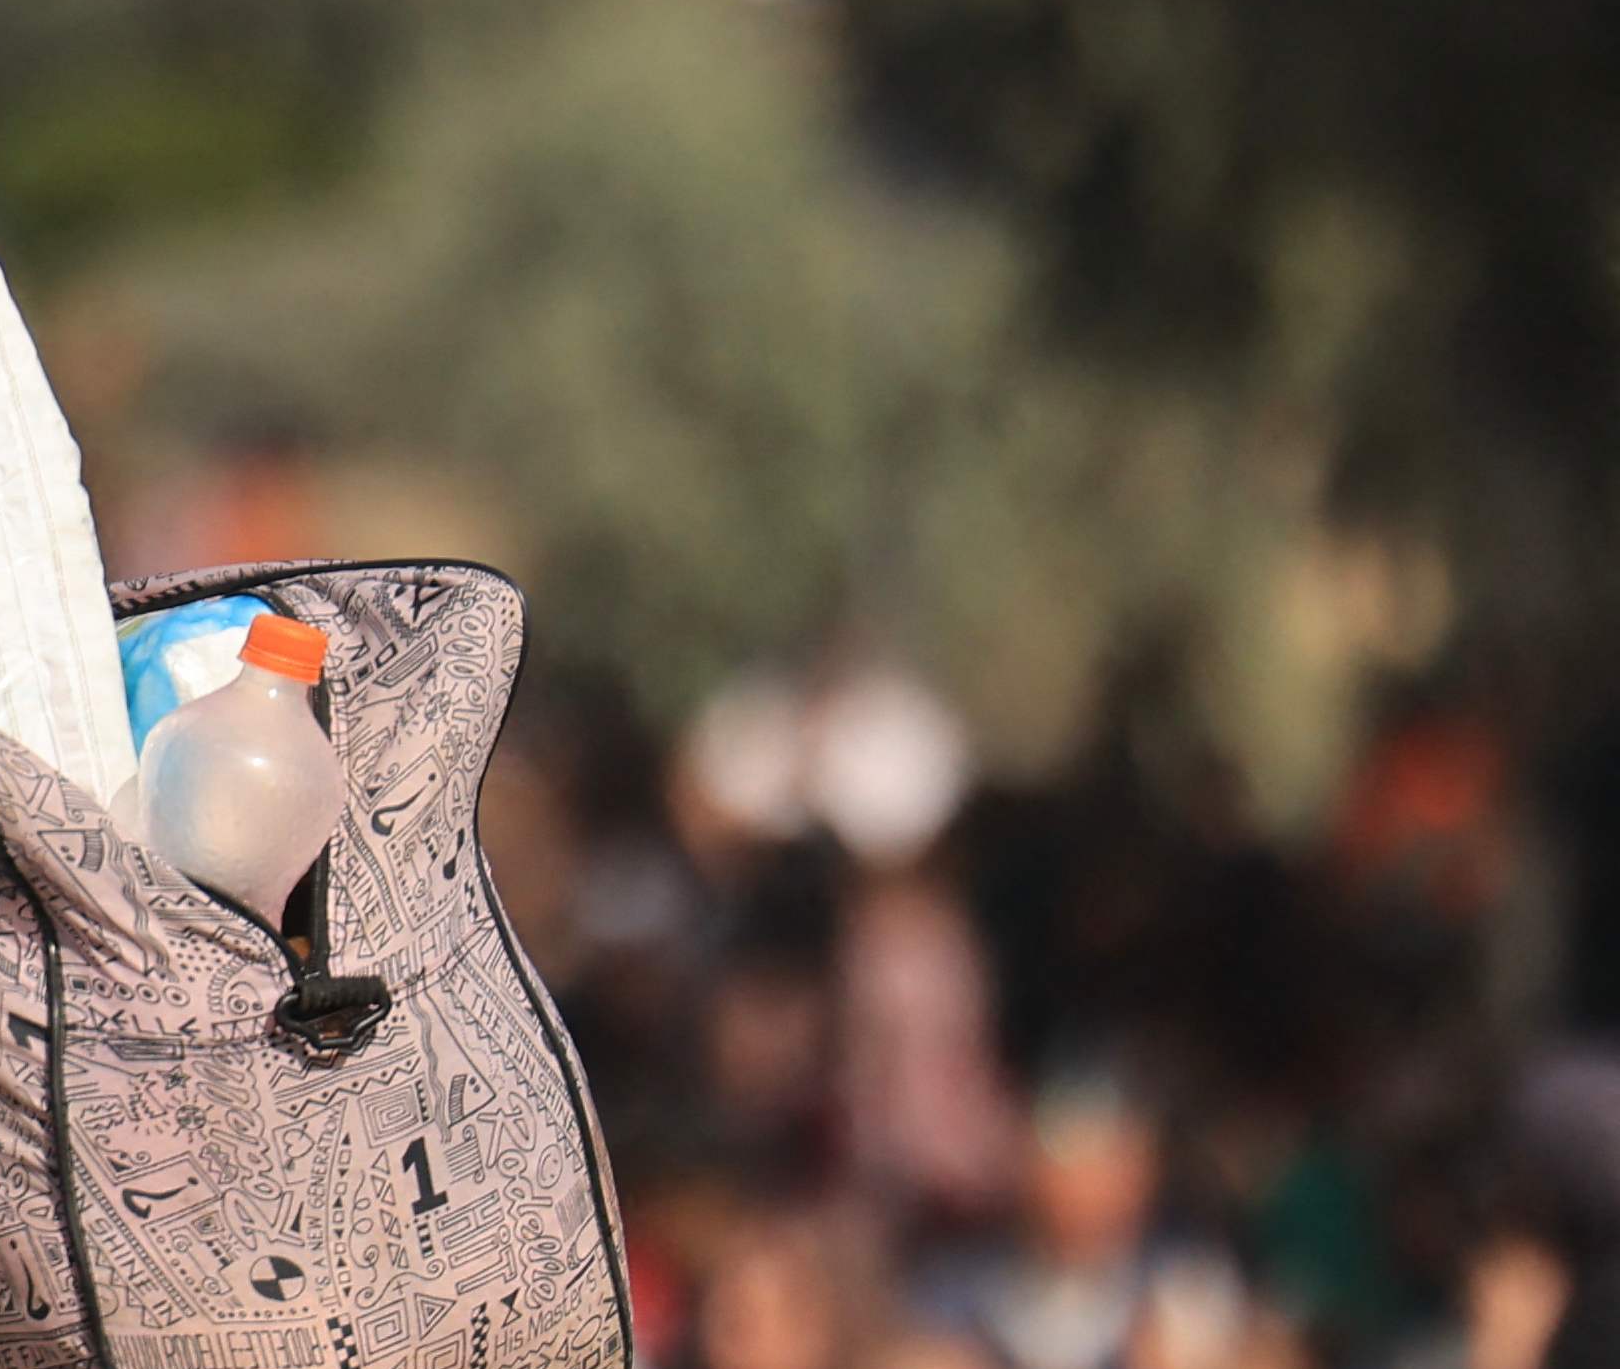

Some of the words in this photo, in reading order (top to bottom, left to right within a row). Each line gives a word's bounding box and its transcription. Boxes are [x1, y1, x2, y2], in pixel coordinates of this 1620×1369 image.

[401, 1136, 448, 1216] 1
[93, 1218, 159, 1294] SHINE
[152, 1299, 182, 1327] IN
[494, 1329, 523, 1361] His
